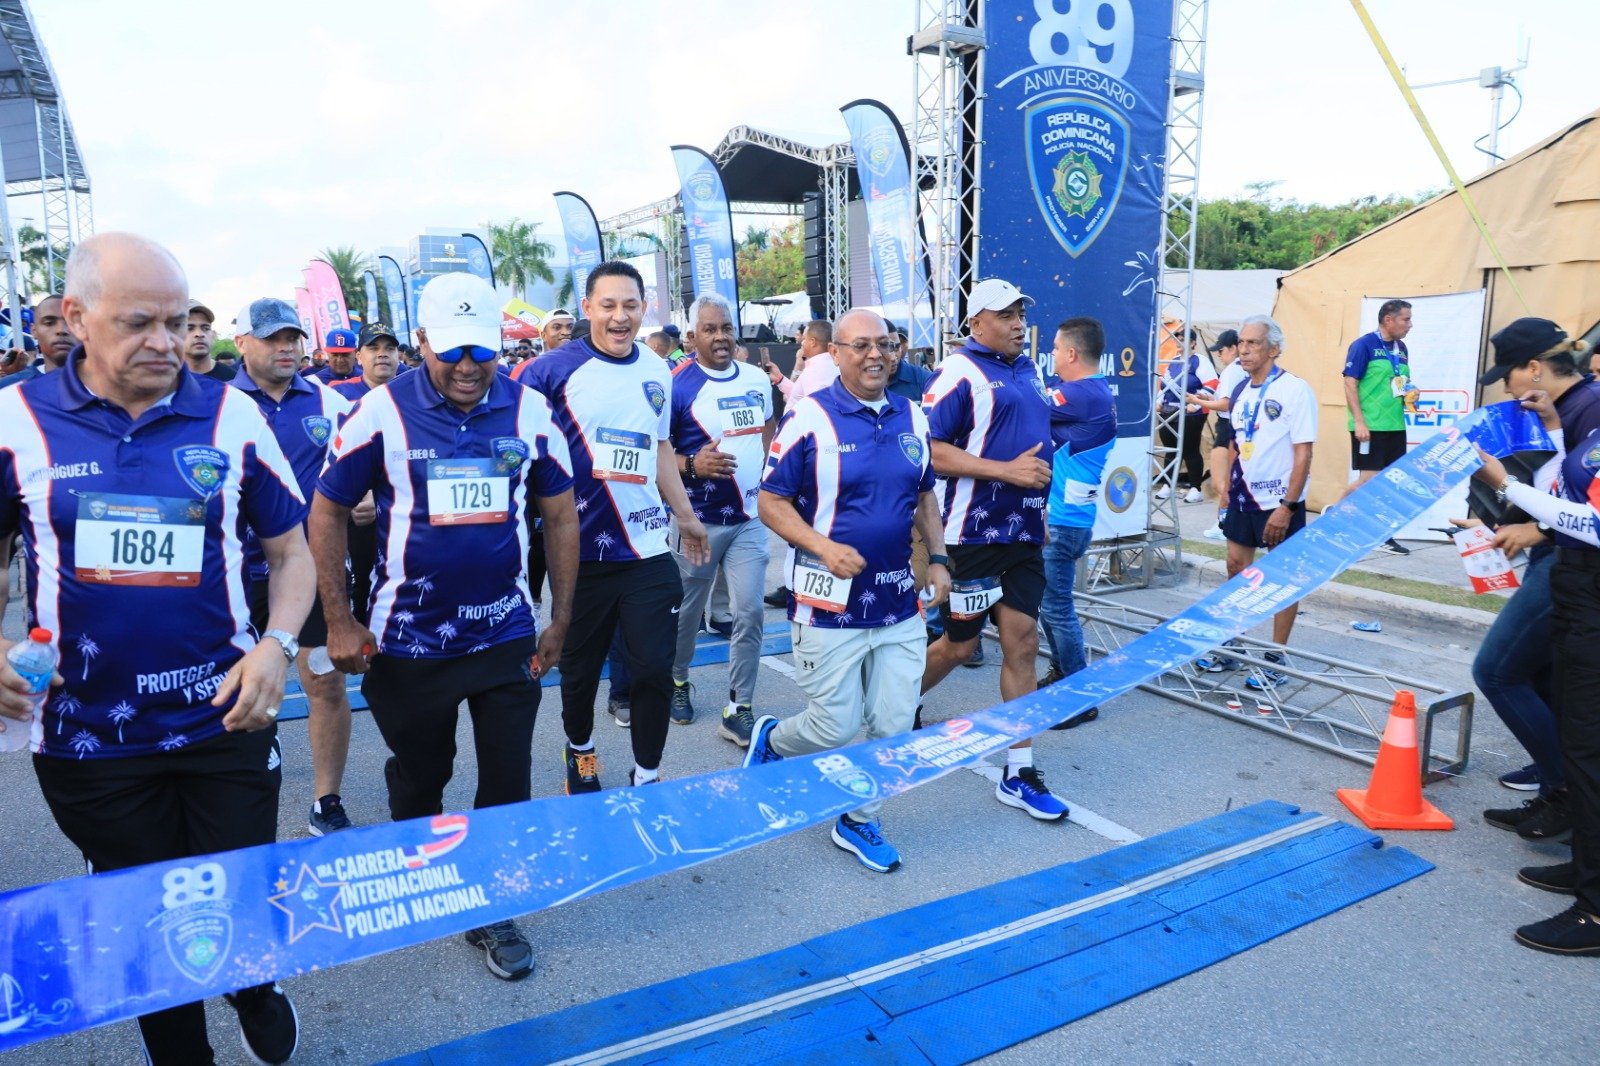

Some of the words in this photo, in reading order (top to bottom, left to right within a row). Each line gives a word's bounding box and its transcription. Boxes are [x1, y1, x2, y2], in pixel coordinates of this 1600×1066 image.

[1029, 0, 1135, 79] 89
[1024, 68, 1136, 110] ANIVERSARIO
[1046, 109, 1111, 135] REPÚBLICA
[1041, 127, 1116, 154] DOMINICANA
[1045, 140, 1075, 155] POLICÍA
[1077, 142, 1113, 164] NACIONAL
[1085, 206, 1105, 232] SERVIR
[731, 410, 755, 427] 1683
[90, 461, 104, 474] G.
[613, 448, 640, 472] 1731
[450, 482, 492, 508] 1729
[1557, 511, 1595, 534] STAFF
[110, 529, 175, 566] 1684
[803, 571, 834, 598] 1733
[964, 592, 990, 612] 1721
[137, 661, 216, 694] PROTEGER
[182, 686, 193, 704] Y
[335, 847, 407, 882] CARRERA
[162, 862, 228, 911] 89
[340, 863, 465, 910] INTERNACIONAL
[344, 901, 412, 940] POLICÍA
[410, 884, 491, 923] NACIONAL
